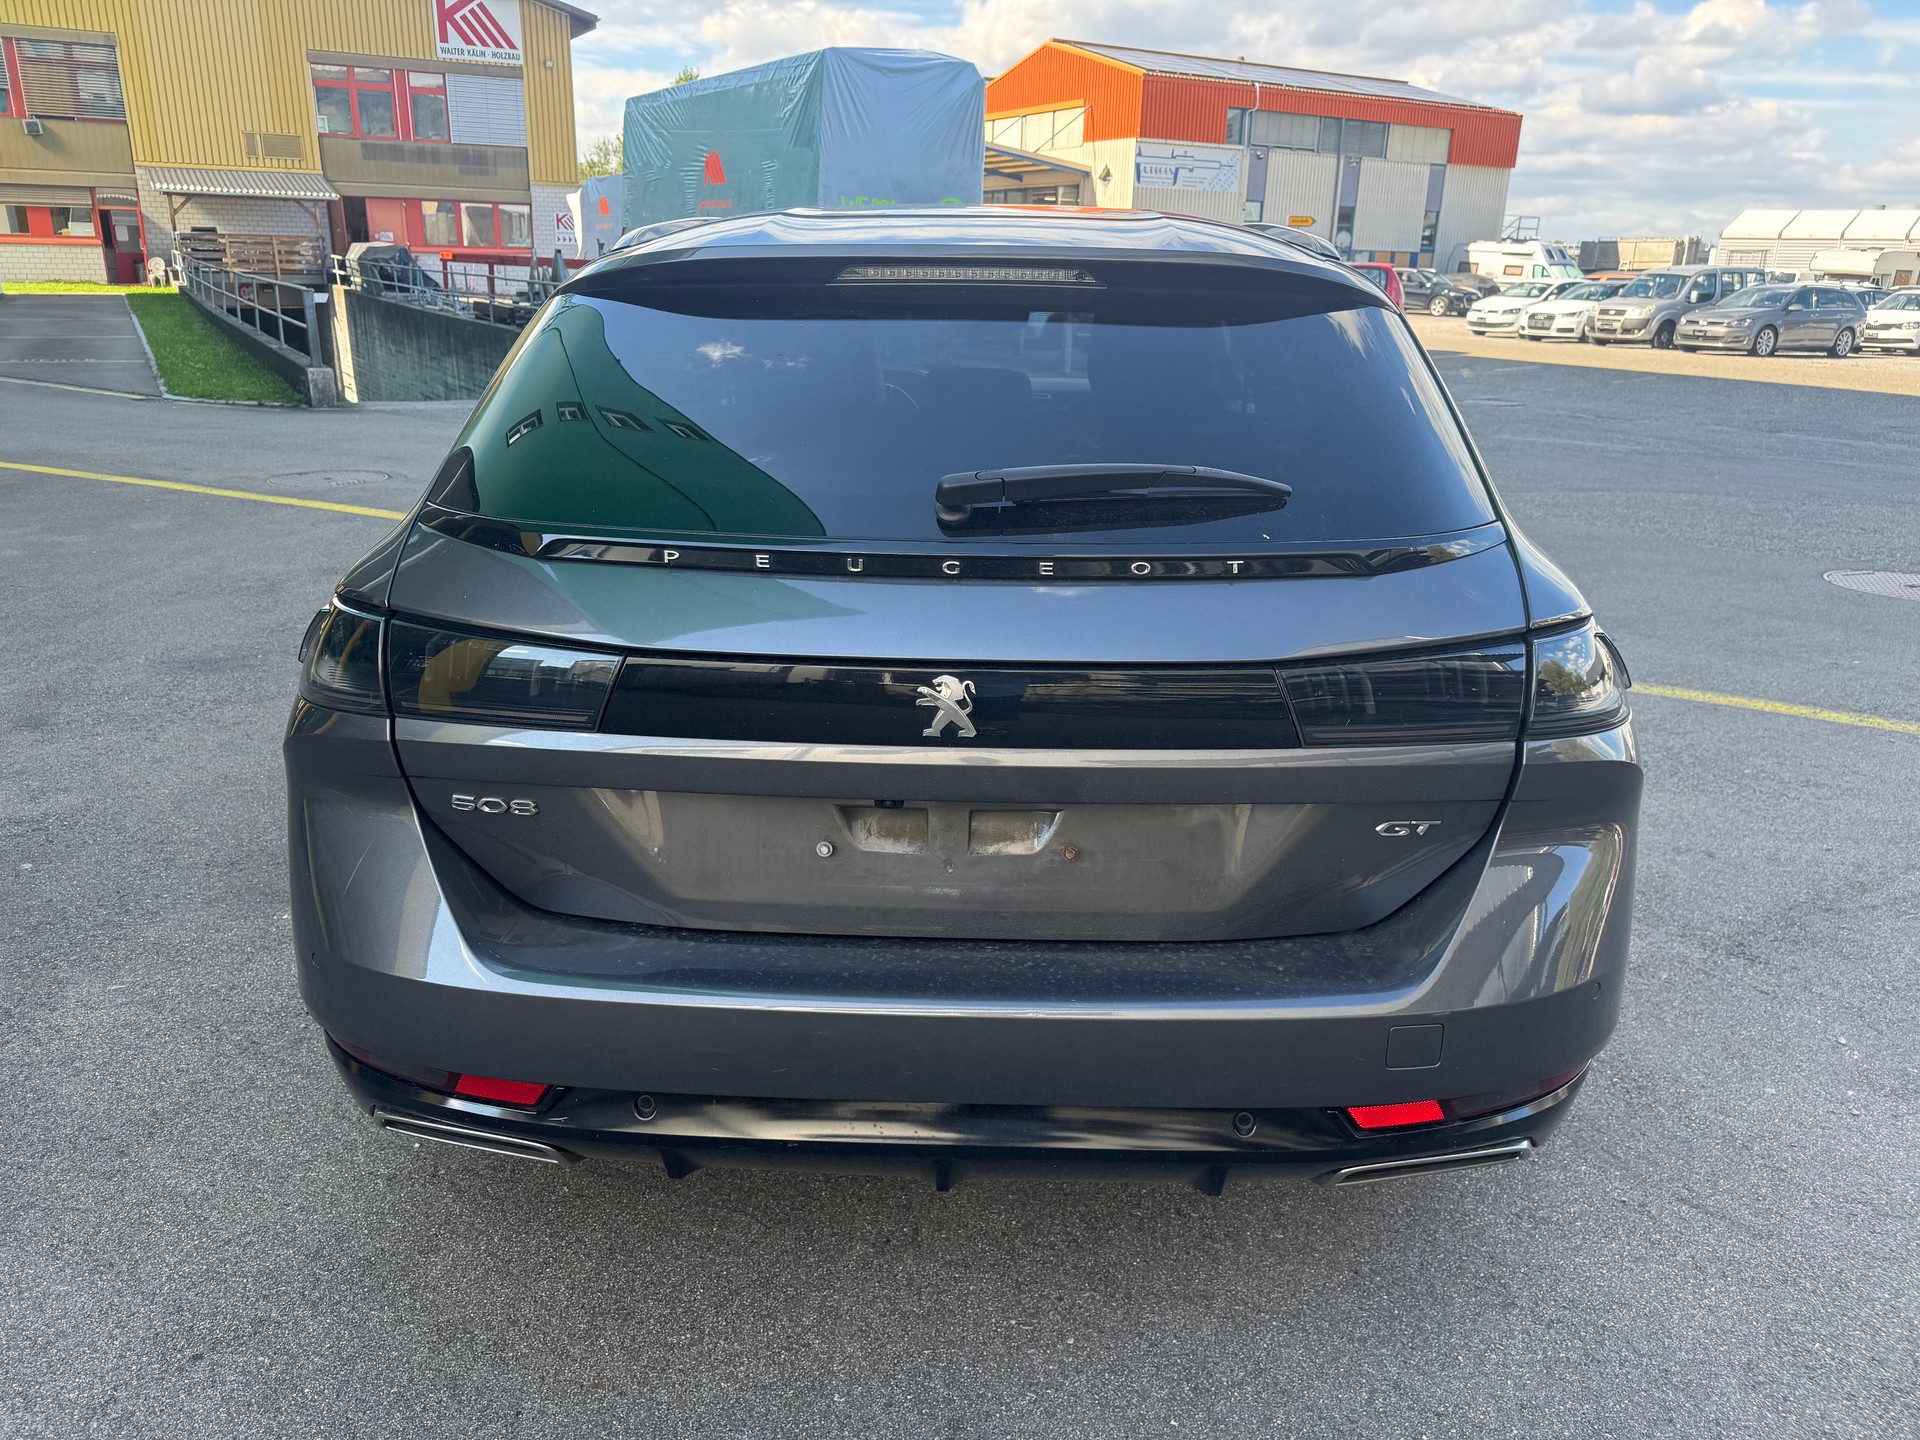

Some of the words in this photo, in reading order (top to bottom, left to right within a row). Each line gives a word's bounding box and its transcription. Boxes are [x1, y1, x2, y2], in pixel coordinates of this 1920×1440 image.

[440, 46, 465, 57] WALTER
[467, 47, 486, 58] KÄLIN
[491, 50, 521, 61] HOLZBAU
[663, 549, 1244, 575] PEUGEOT
[452, 794, 539, 816] 508
[1375, 820, 1442, 836] GT
